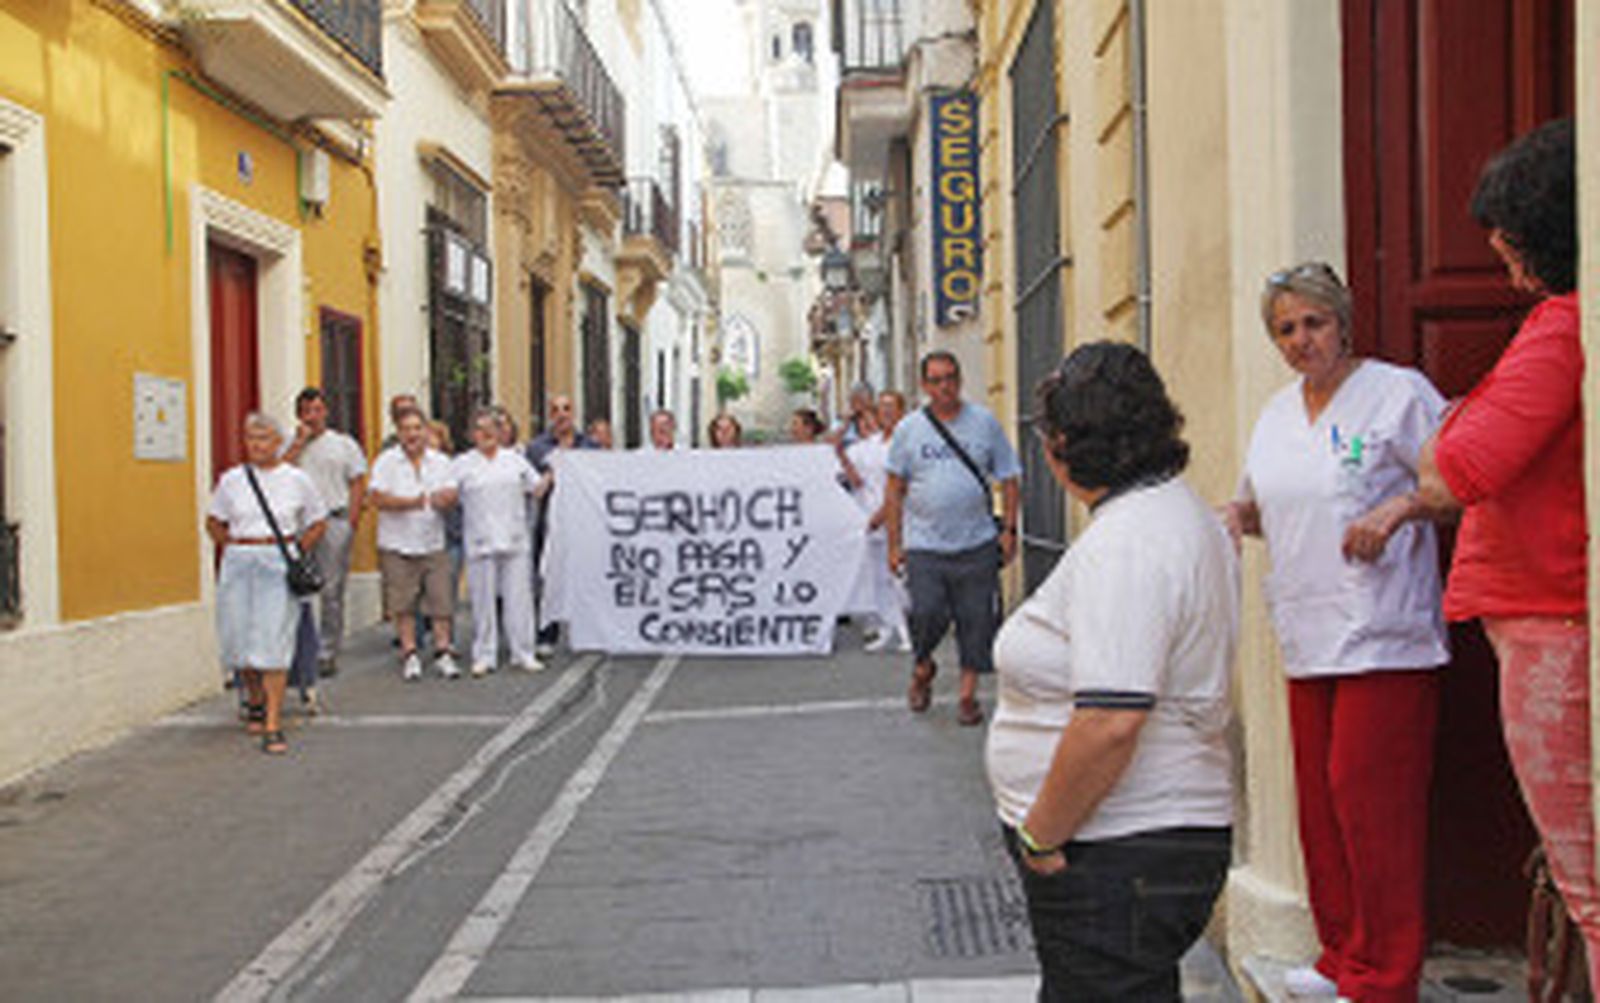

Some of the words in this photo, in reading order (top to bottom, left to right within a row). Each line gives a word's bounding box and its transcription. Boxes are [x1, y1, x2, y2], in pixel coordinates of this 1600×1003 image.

[610, 543, 661, 578] NO
[677, 538, 764, 573] PAGA
[782, 534, 809, 570] Y
[609, 574, 660, 607] EL
[667, 572, 757, 611] SAS
[773, 581, 818, 604] LO
